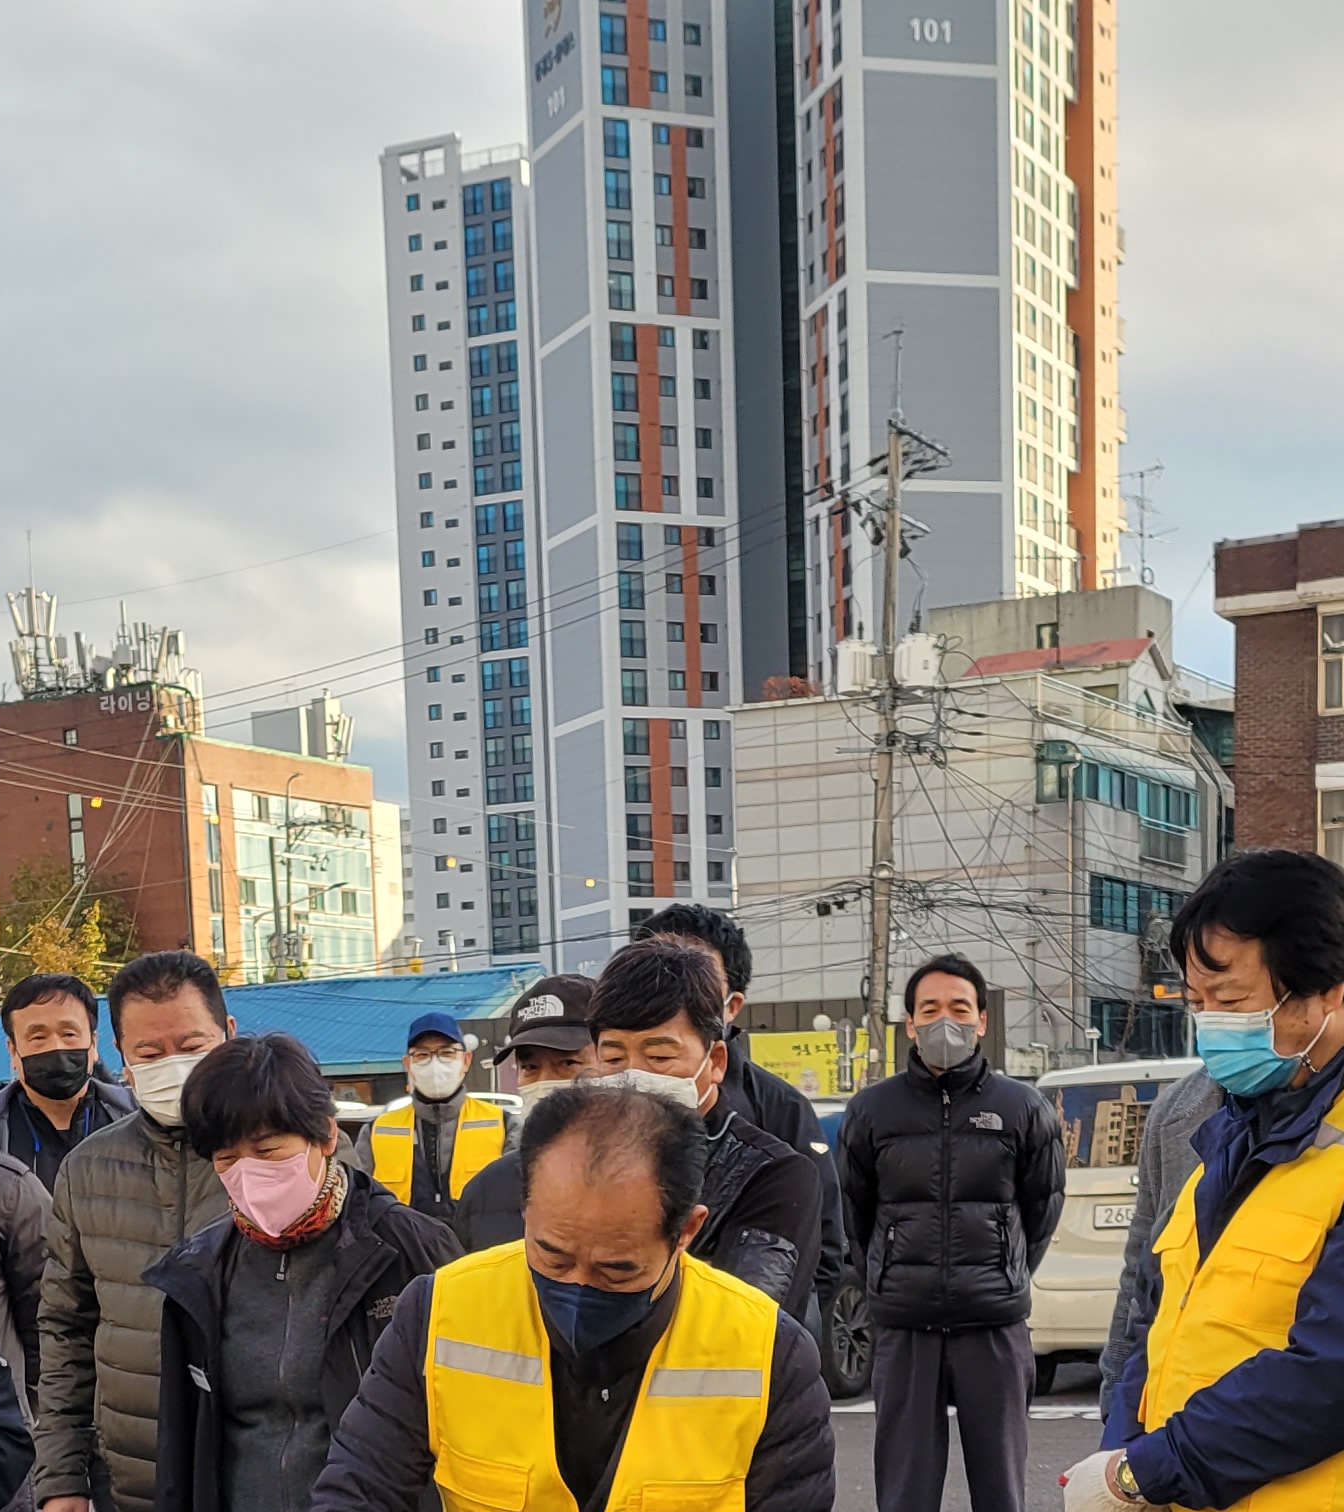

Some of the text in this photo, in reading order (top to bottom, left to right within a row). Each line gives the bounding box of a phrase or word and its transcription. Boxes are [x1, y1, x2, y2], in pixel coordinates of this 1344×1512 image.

[909, 17, 952, 44] 101
[528, 996, 546, 1007] THE
[517, 1004, 546, 1019] NORTH
